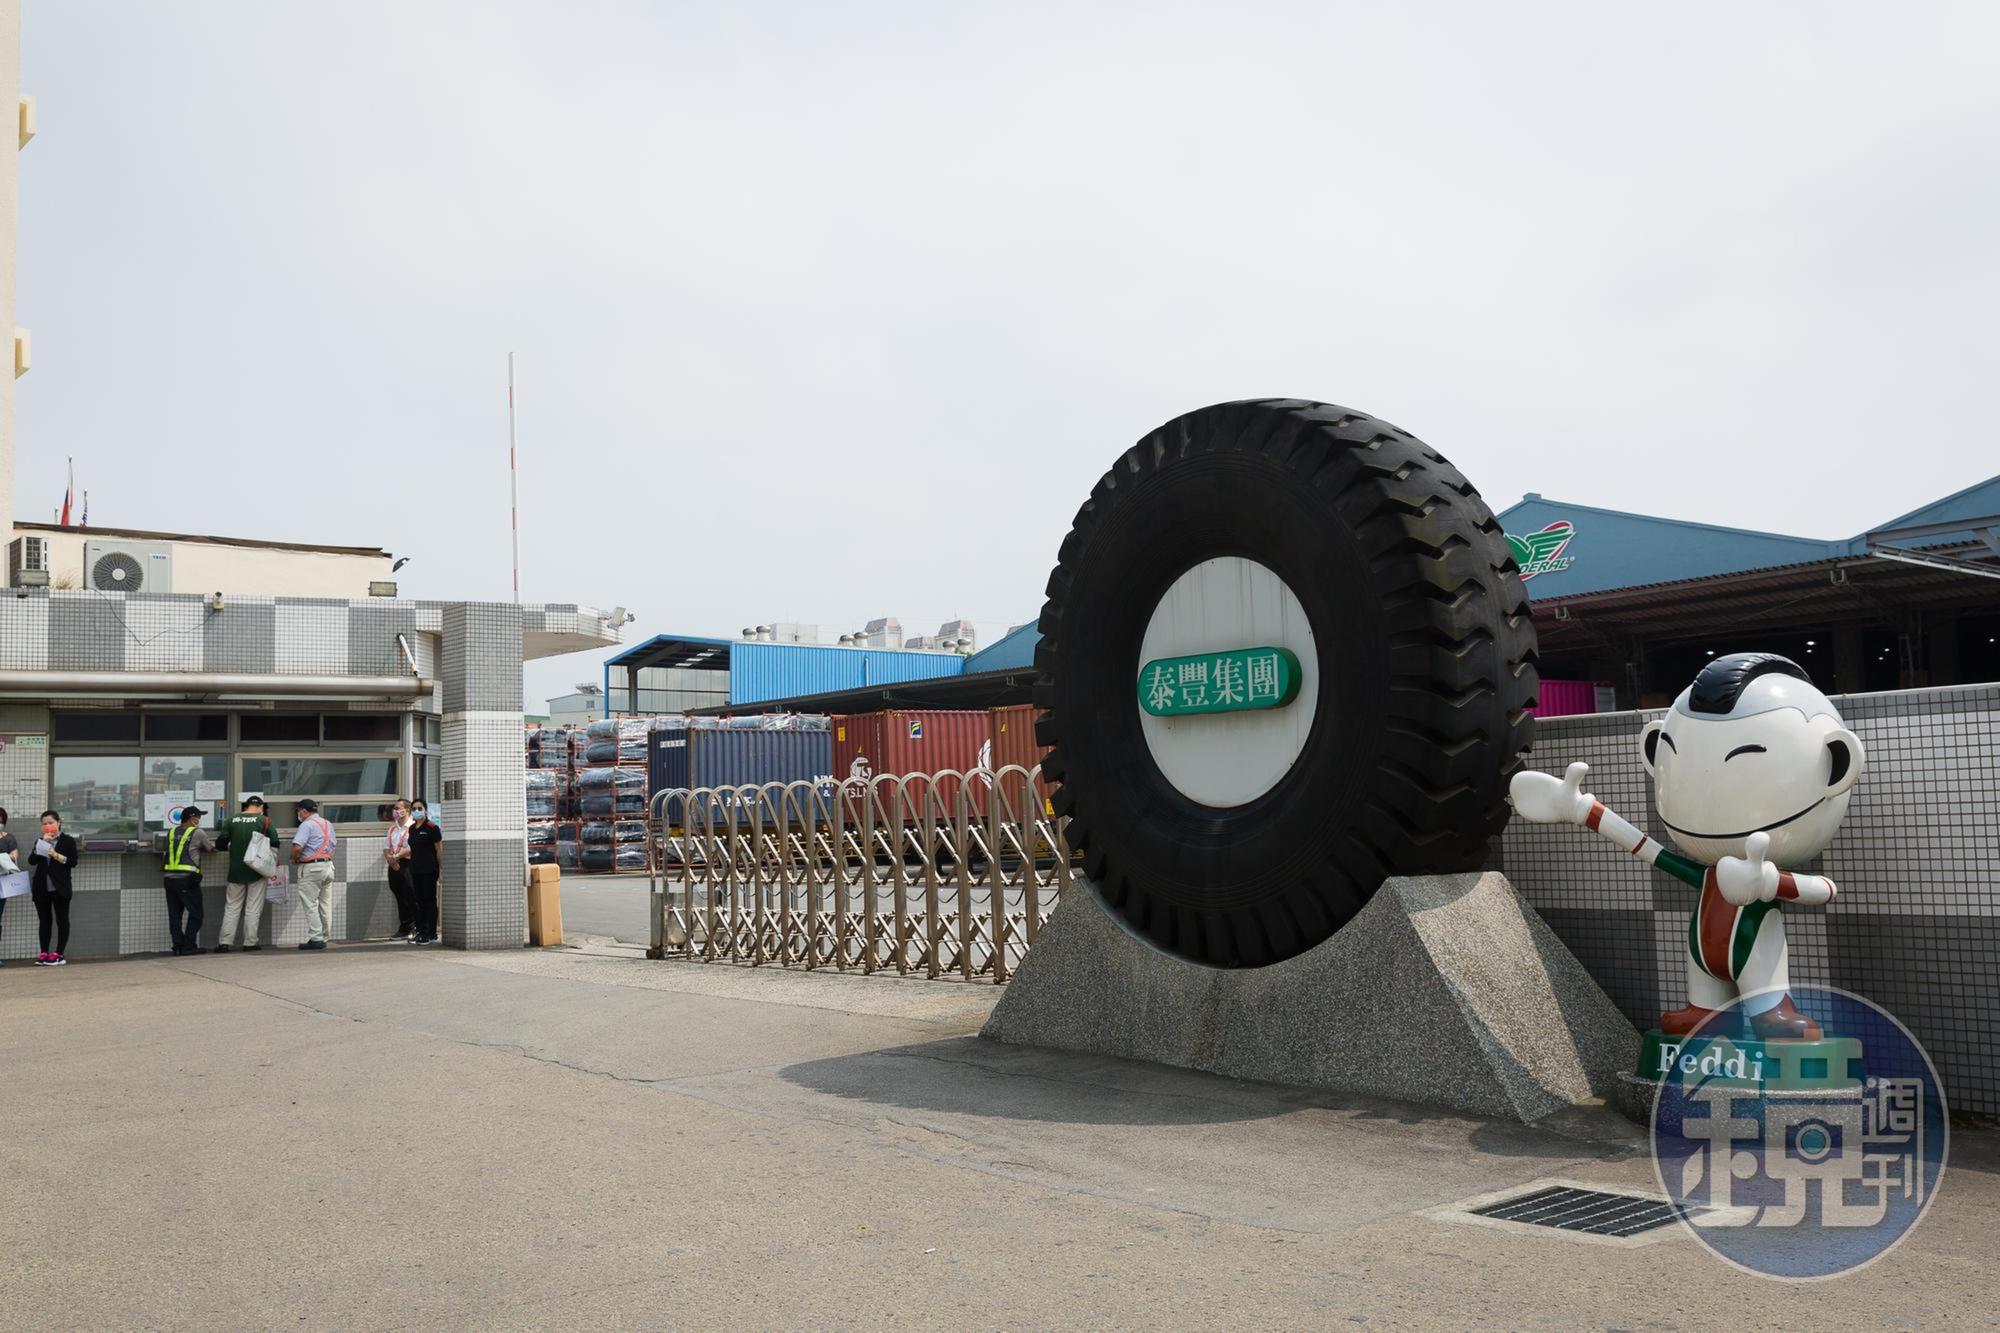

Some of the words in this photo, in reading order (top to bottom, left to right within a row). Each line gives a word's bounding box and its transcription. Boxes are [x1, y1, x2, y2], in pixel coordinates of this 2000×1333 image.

[1519, 557, 1569, 574] DERAL
[1145, 653, 1280, 711] 泰豐集團
[1657, 1043, 1764, 1081] Feddi
